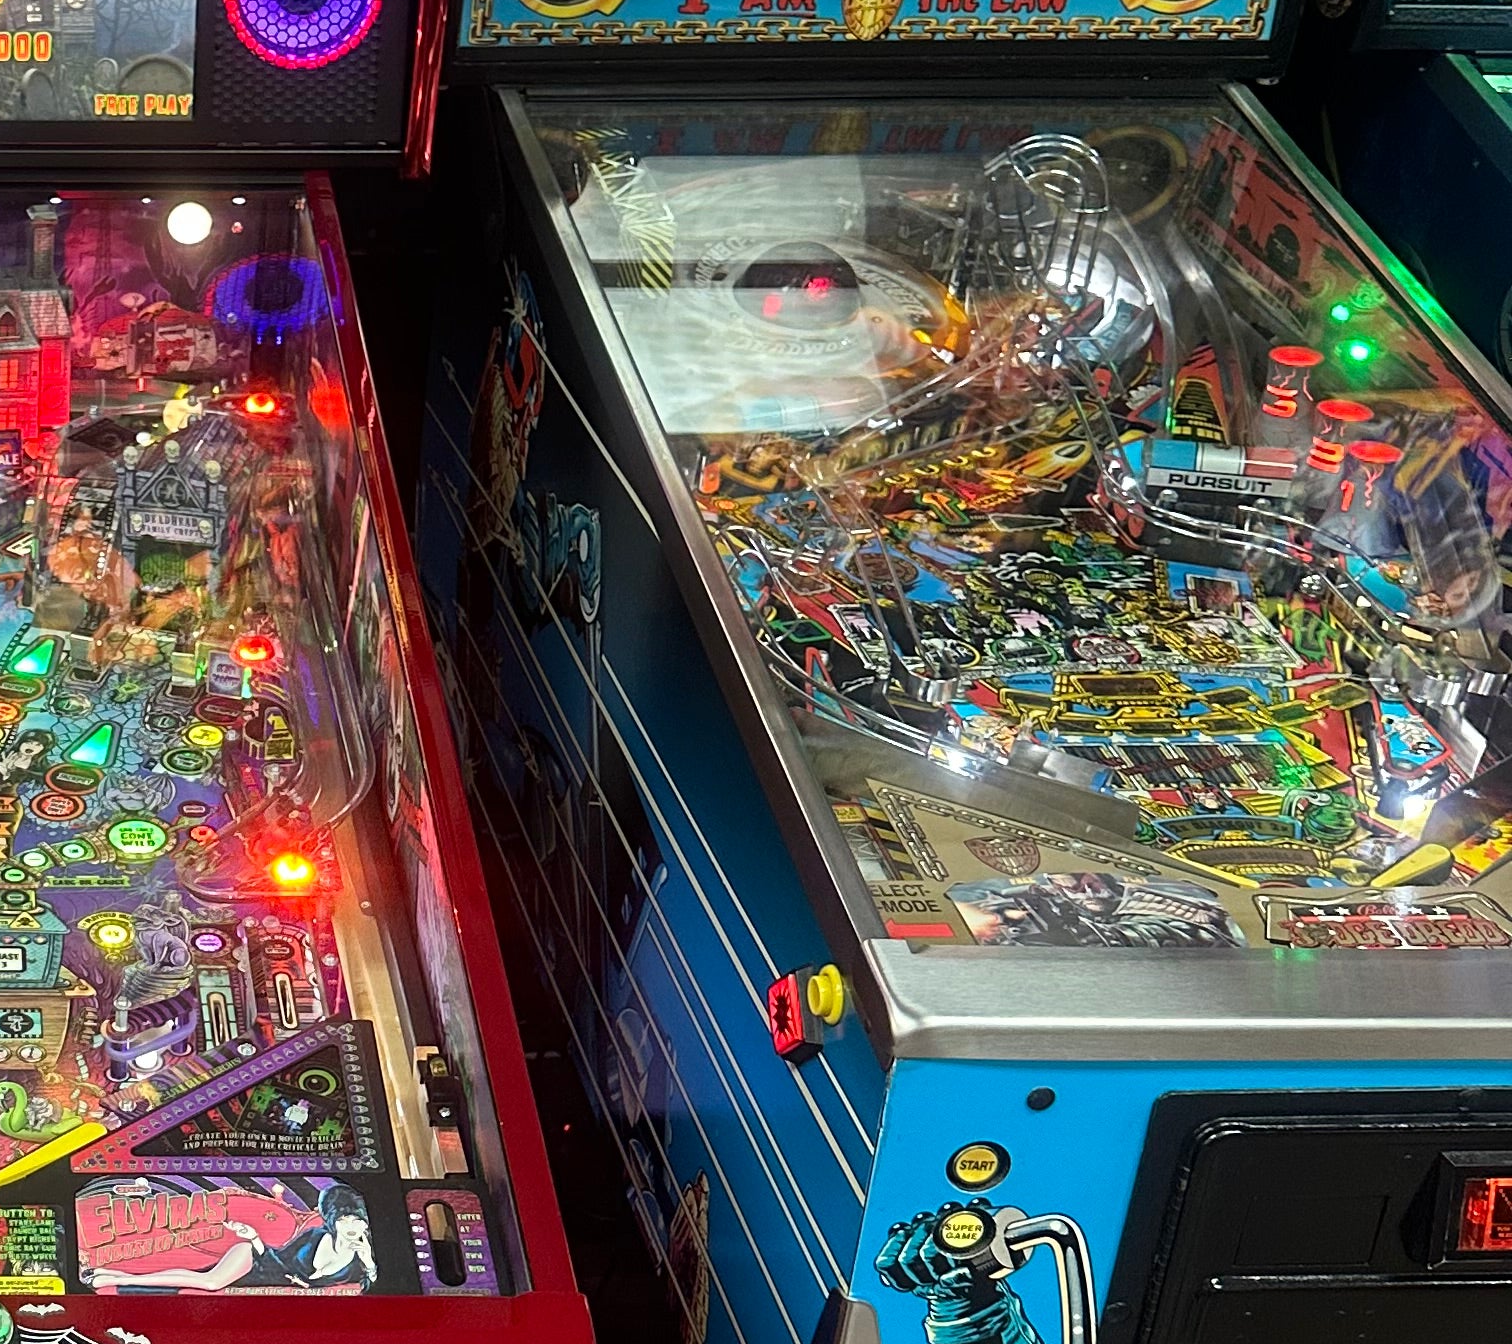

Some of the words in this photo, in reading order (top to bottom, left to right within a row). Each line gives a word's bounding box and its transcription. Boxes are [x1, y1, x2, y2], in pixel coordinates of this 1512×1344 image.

[94, 93, 138, 116] FREE
[143, 93, 193, 116] PLAY
[1168, 473, 1272, 494] PURSUIT
[183, 1141, 200, 1149] AND
[277, 1143, 315, 1151] CRITICAL
[959, 1160, 995, 1171] START
[945, 1224, 983, 1232] SUPER
[945, 1232, 977, 1240] GAME
[96, 1239, 153, 1267] HOUSE
